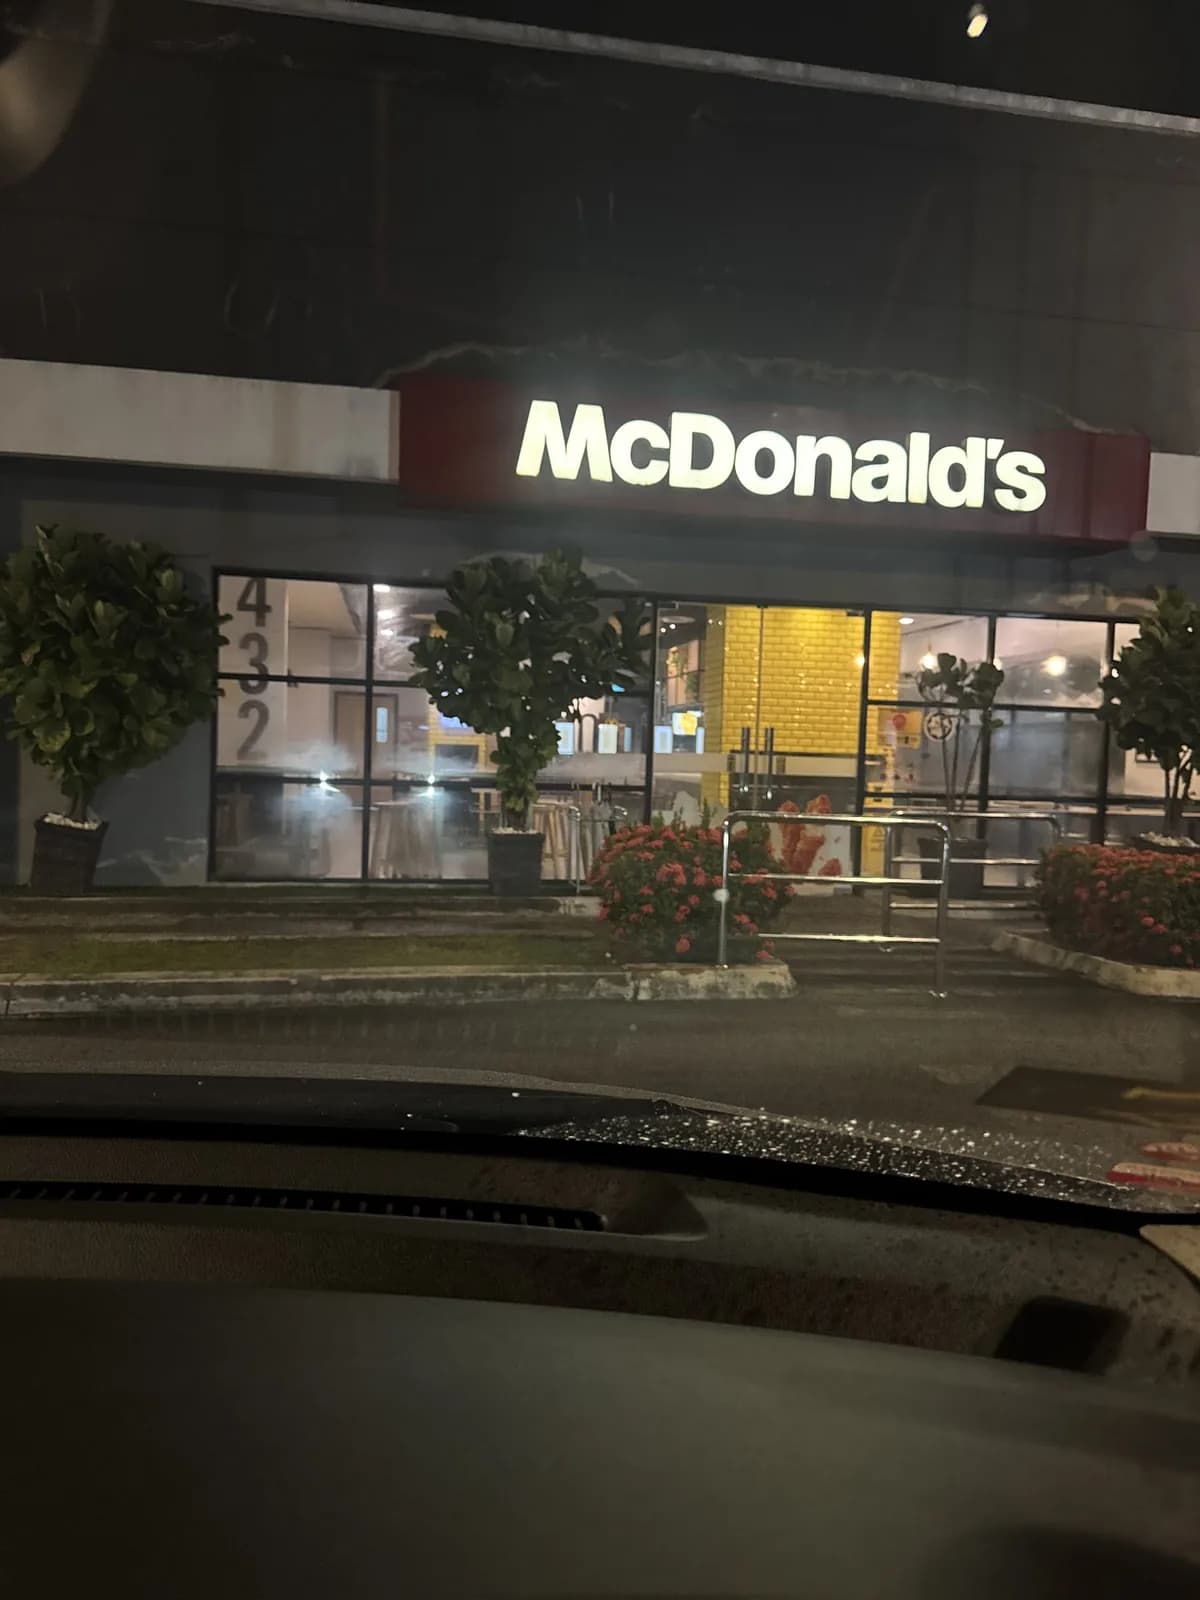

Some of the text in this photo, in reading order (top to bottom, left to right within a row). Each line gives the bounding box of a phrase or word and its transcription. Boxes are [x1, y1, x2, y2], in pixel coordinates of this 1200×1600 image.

[515, 399, 1047, 512] McDonald's
[237, 578, 271, 627] 4
[238, 632, 269, 694] 3
[237, 700, 269, 761] 2
